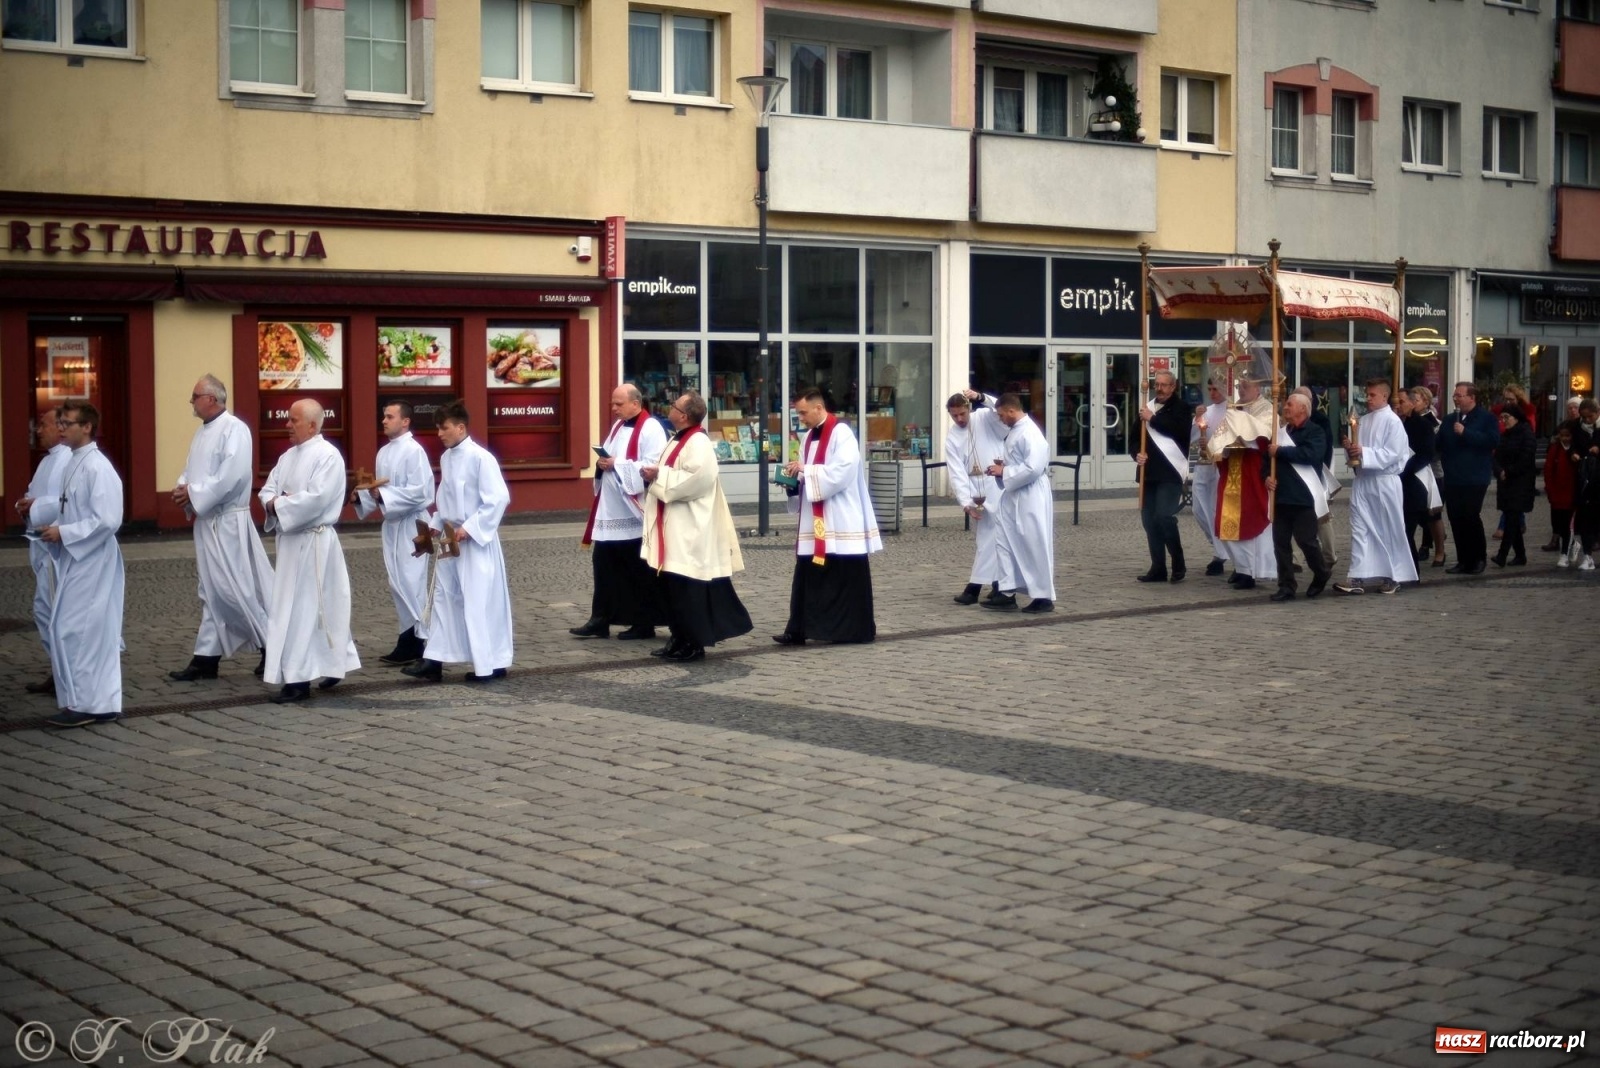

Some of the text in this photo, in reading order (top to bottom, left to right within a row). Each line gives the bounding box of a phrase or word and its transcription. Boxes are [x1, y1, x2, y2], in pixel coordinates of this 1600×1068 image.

[8, 220, 327, 258] RESTAURACJA
[608, 221, 616, 273] ŻYWIEC
[628, 275, 697, 296] empik.com
[545, 294, 566, 303] SMAKI
[567, 293, 591, 303] ŚWIATA
[1060, 277, 1135, 316] empik
[1406, 302, 1447, 318] empik.com
[501, 407, 525, 415] SMAKI
[526, 405, 554, 415] ŚWIATA
